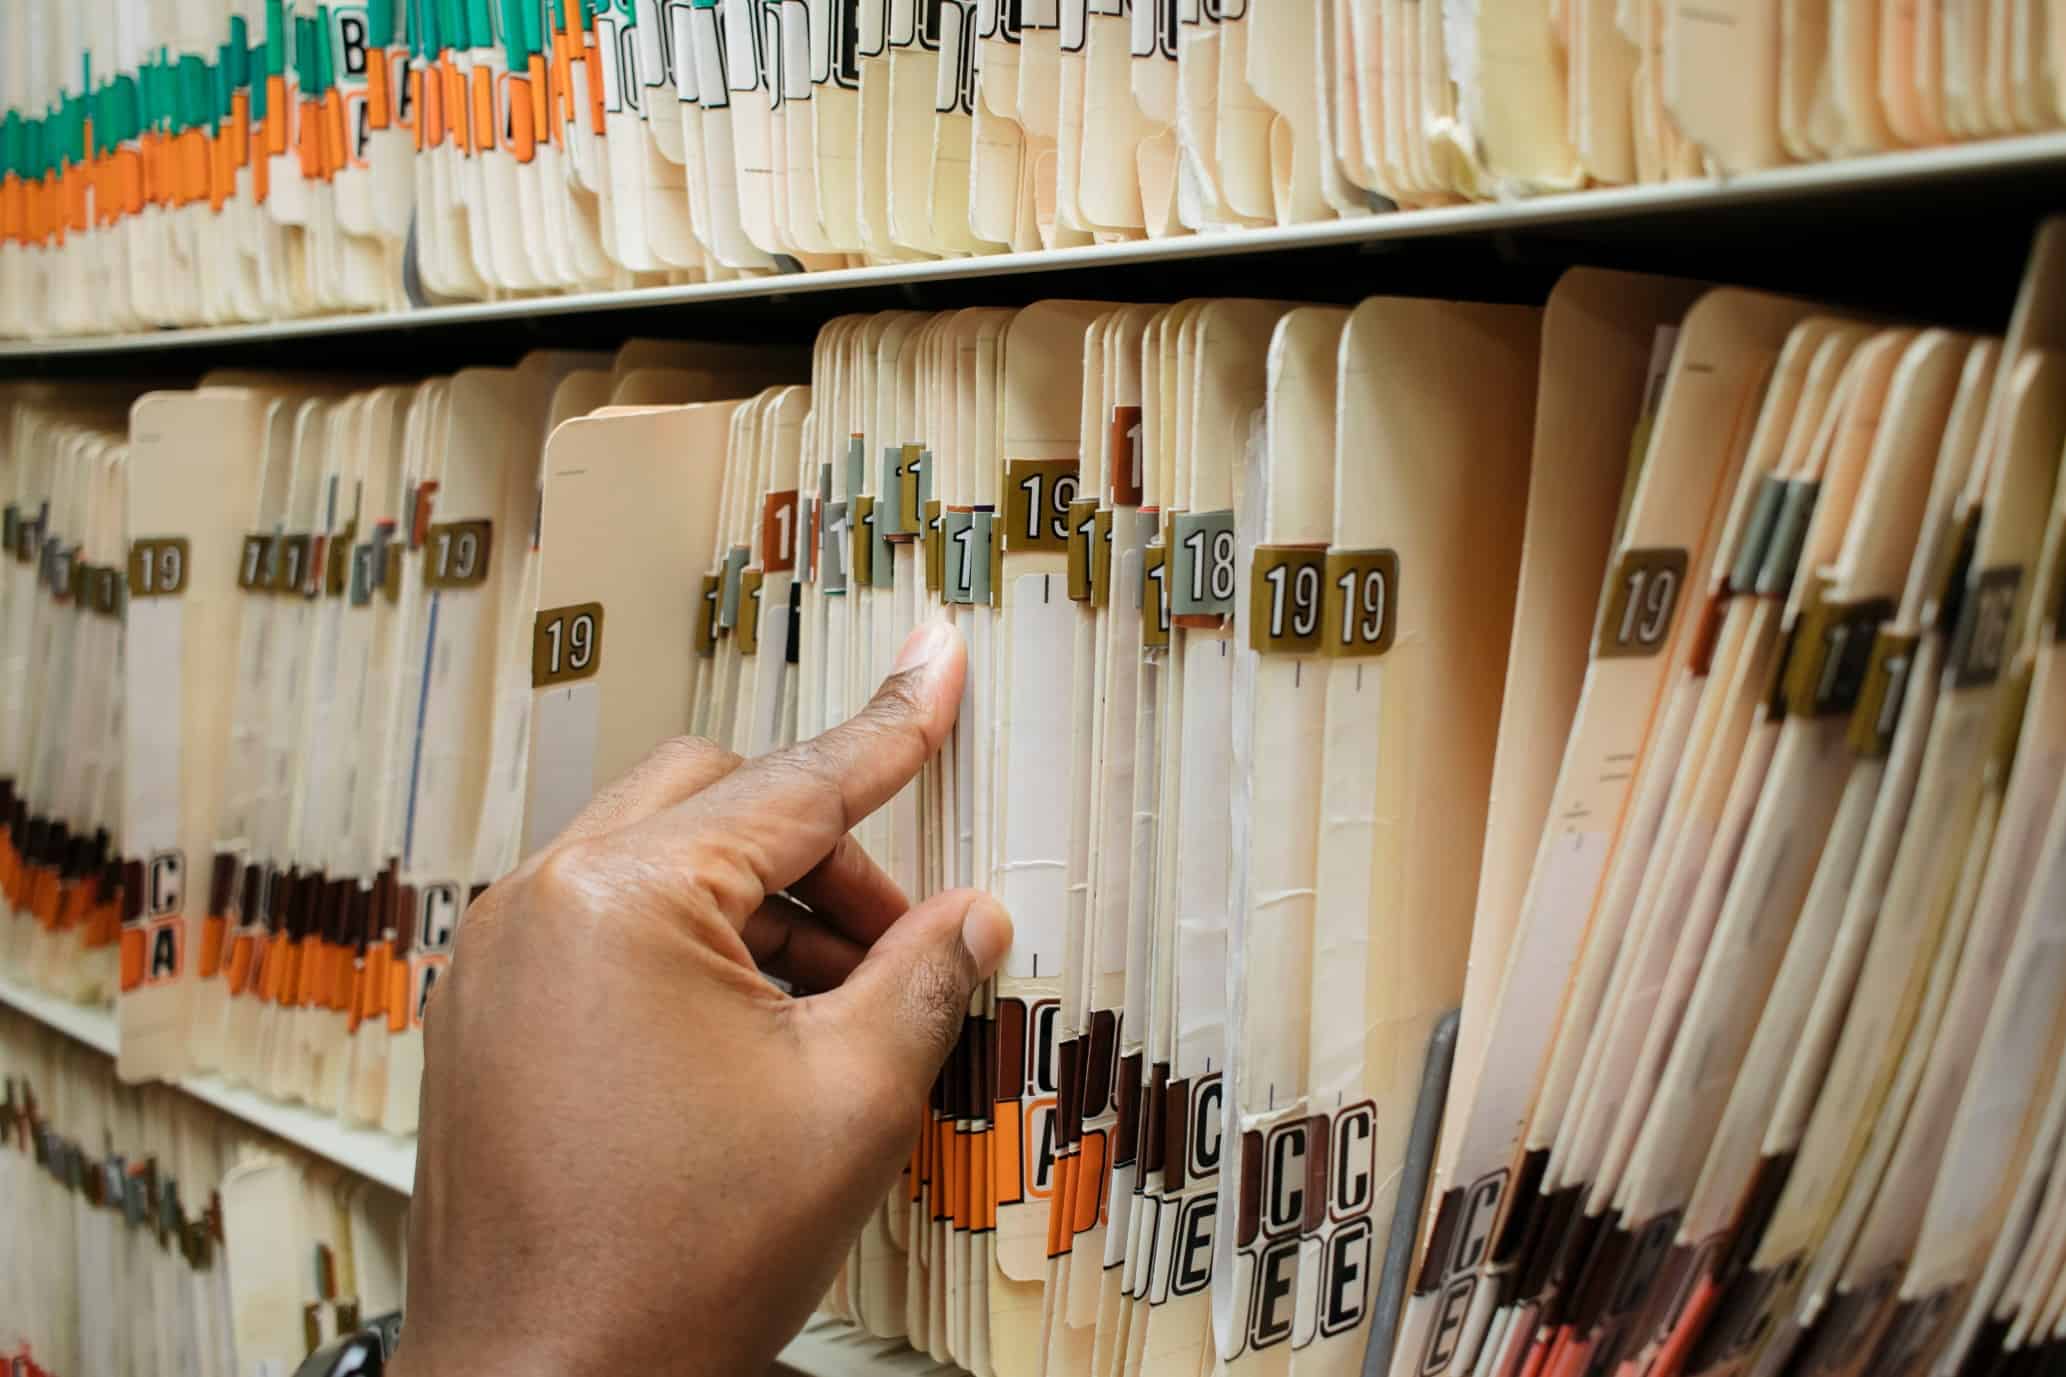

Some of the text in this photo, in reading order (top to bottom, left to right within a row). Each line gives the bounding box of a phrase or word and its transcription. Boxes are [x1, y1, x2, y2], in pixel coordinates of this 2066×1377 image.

[341, 18, 367, 74] B
[775, 504, 791, 561] 1
[1020, 474, 1080, 540] 19
[142, 545, 182, 592] 19
[436, 532, 477, 579] 19
[953, 526, 974, 591] 1
[1184, 530, 1234, 603] 18
[1266, 562, 1319, 638] 19
[1338, 568, 1386, 646] 19
[1618, 570, 1676, 643] 19
[546, 614, 594, 676] 19
[151, 856, 177, 910] C
[422, 888, 452, 948] C
[151, 926, 176, 977] A
[1195, 1082, 1223, 1168] C
[1338, 1111, 1369, 1211] C
[1270, 1128, 1304, 1227] C
[1181, 1202, 1217, 1286] E
[1453, 1180, 1500, 1274] C
[1258, 1241, 1299, 1341] E
[1328, 1226, 1364, 1327] E
[1427, 1284, 1472, 1370] E
